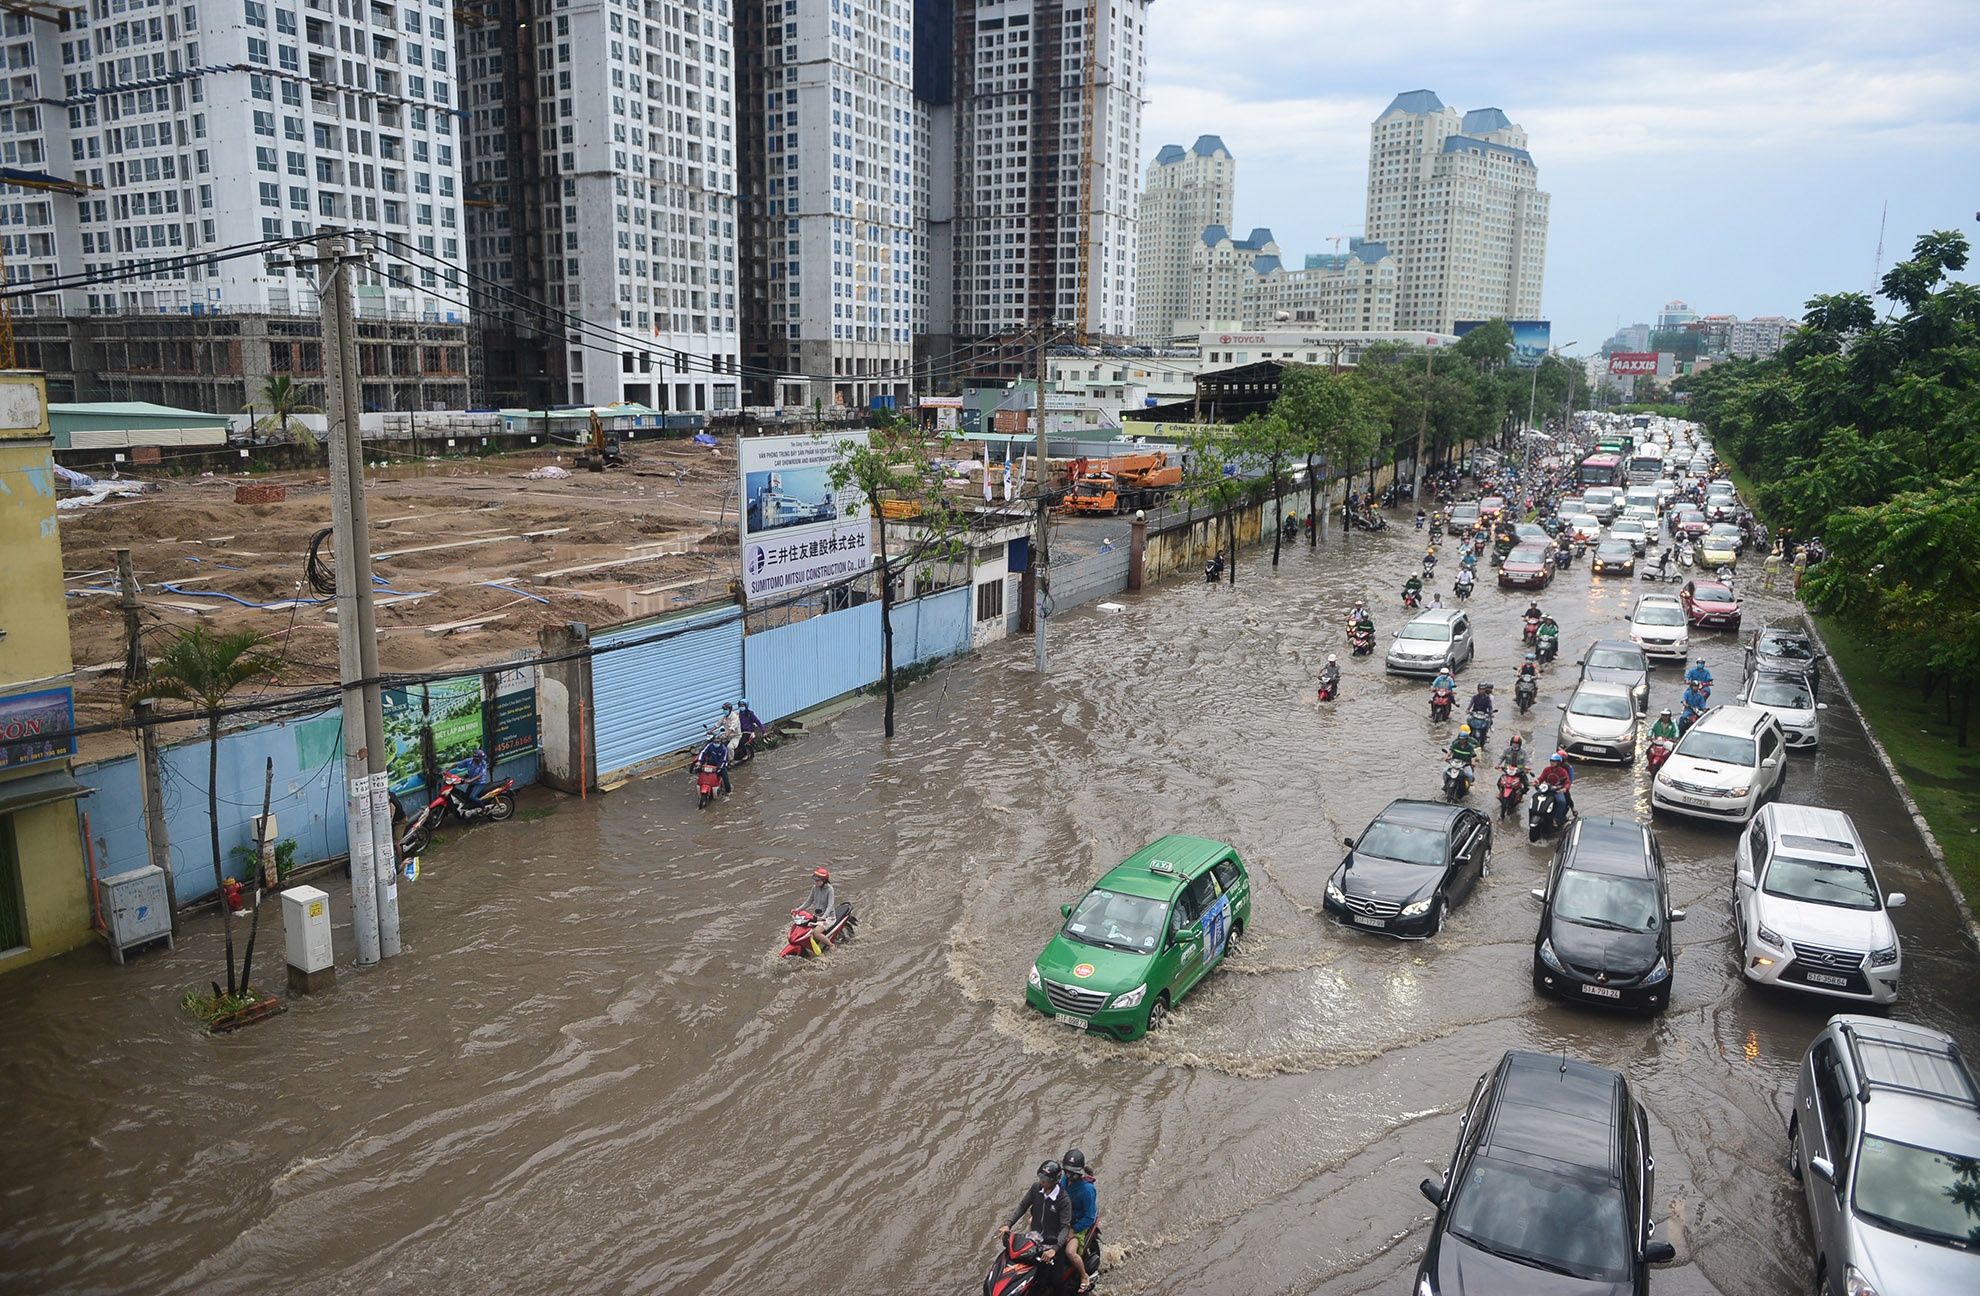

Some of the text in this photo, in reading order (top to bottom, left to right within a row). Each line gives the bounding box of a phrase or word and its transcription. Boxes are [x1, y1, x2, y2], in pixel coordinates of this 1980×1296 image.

[1611, 358, 1656, 371] MAXXIS
[782, 458, 801, 466] SHOWROOM
[768, 532, 865, 565] 三井住友建設株式会社
[751, 575, 784, 593] SUMITOMO
[785, 571, 805, 586] MITSUI
[806, 562, 846, 581] CONSTRUCTION
[1150, 860, 1169, 870] TAXI
